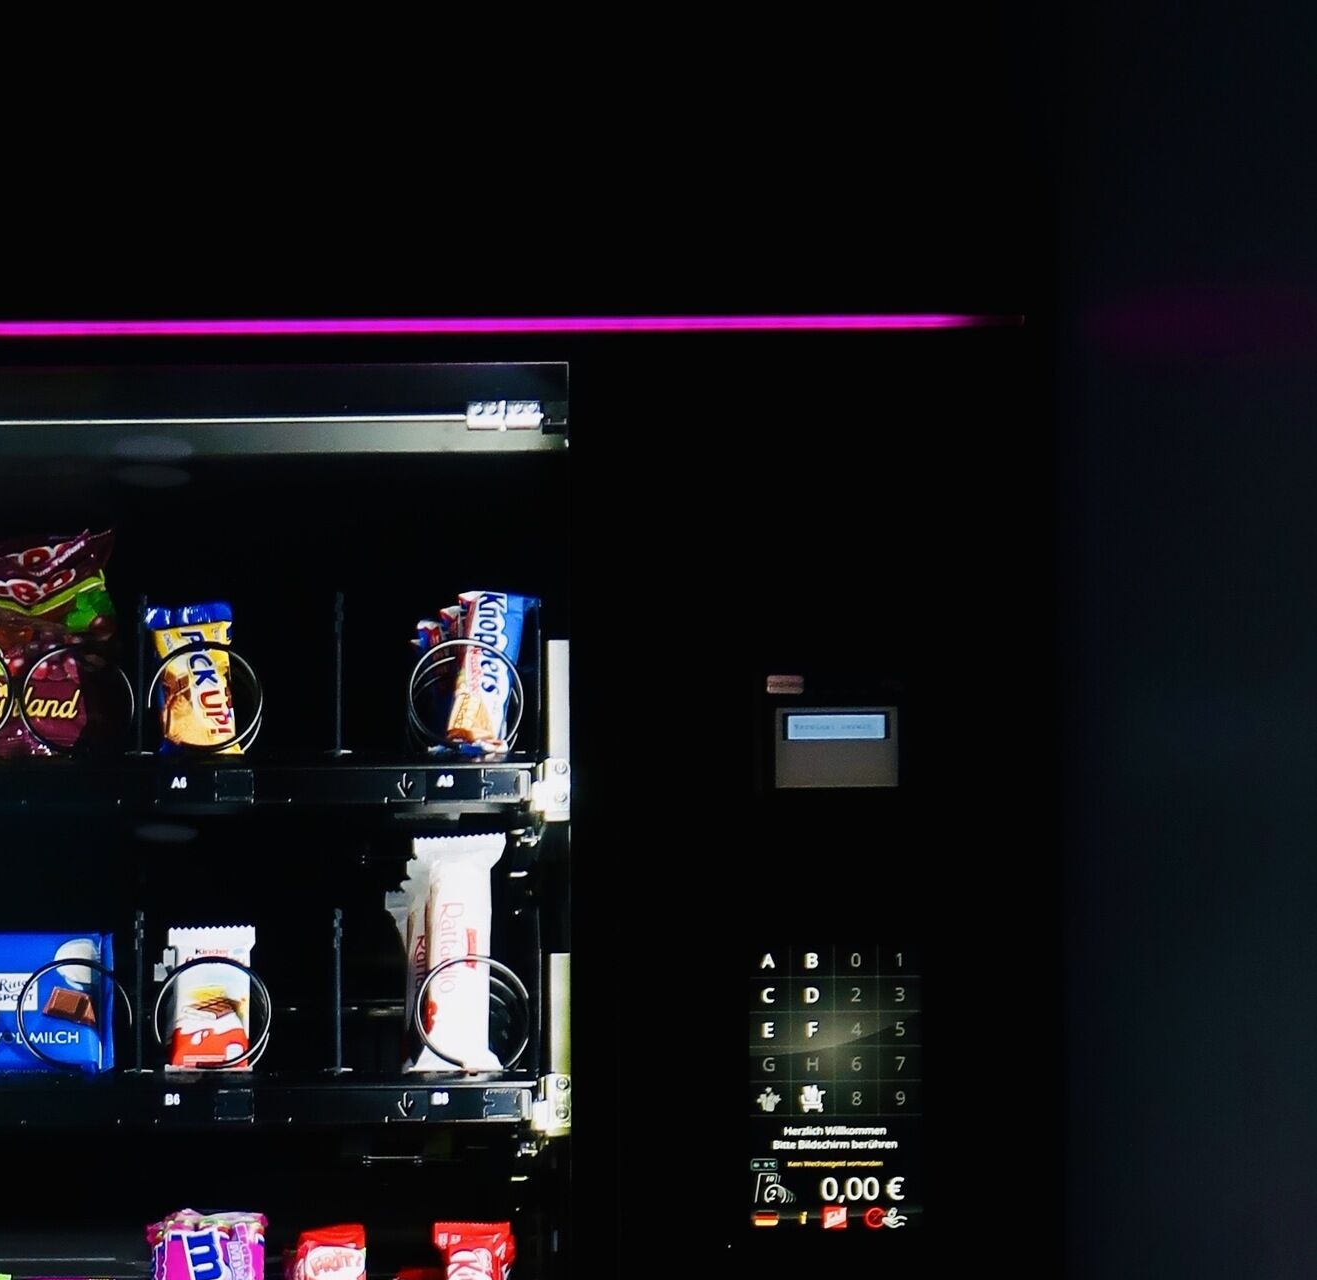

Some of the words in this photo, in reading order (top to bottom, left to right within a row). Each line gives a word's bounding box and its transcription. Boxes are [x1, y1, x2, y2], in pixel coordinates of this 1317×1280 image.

[171, 777, 187, 789] A6
[761, 953, 775, 969] A
[805, 952, 819, 969] B
[896, 953, 903, 967] 1
[762, 987, 775, 1004] C
[805, 987, 820, 1004] D
[851, 987, 862, 1002] 2
[895, 987, 905, 1002] 3
[763, 1022, 775, 1038] E
[807, 1021, 819, 1038] F
[851, 1022, 862, 1036] 4
[895, 1021, 905, 1036] 5
[763, 1057, 775, 1072] G
[806, 1057, 819, 1071] H
[851, 1056, 862, 1071] 6
[895, 1056, 905, 1071] 7
[164, 1093, 181, 1106] B6
[852, 1091, 862, 1106] 8
[895, 1091, 906, 1106] 9
[783, 1126, 823, 1136] Herzlich
[824, 1126, 887, 1136] Willkommen
[772, 1140, 797, 1150] Bitte
[798, 1140, 850, 1150] Bildschirm
[851, 1140, 898, 1150] berühren
[821, 1176, 880, 1204] 0,00
[886, 1176, 905, 1201] €
